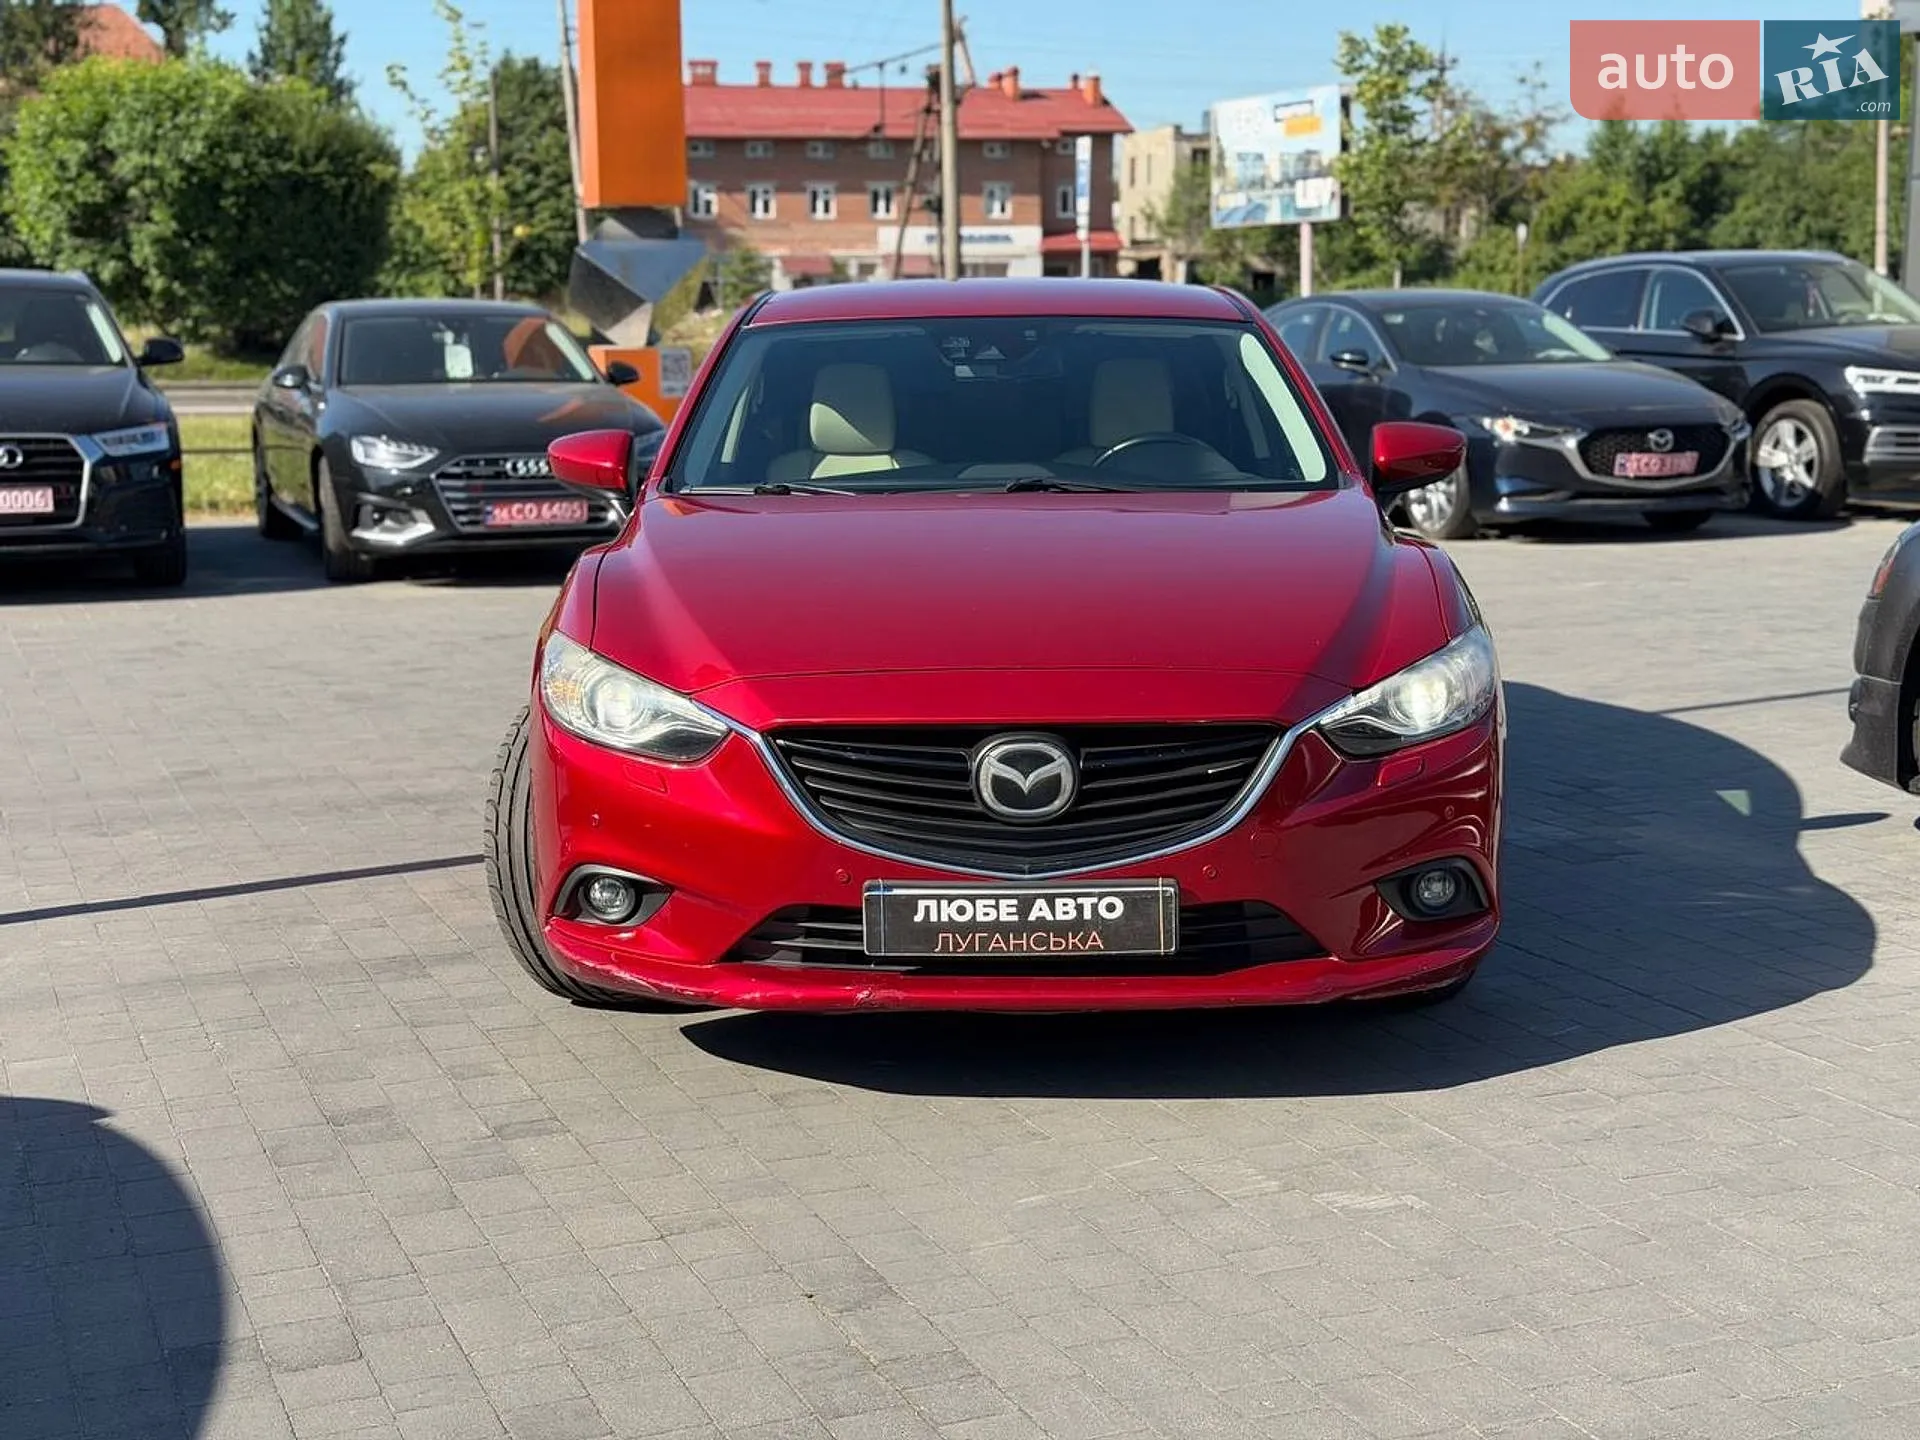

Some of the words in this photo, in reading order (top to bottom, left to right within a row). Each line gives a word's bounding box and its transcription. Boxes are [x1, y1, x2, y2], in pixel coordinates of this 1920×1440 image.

[913, 899, 1018, 922] ЛЮБЕ
[1028, 896, 1124, 921] АВТО
[934, 931, 1104, 952] ЛУГАНСЬКА
